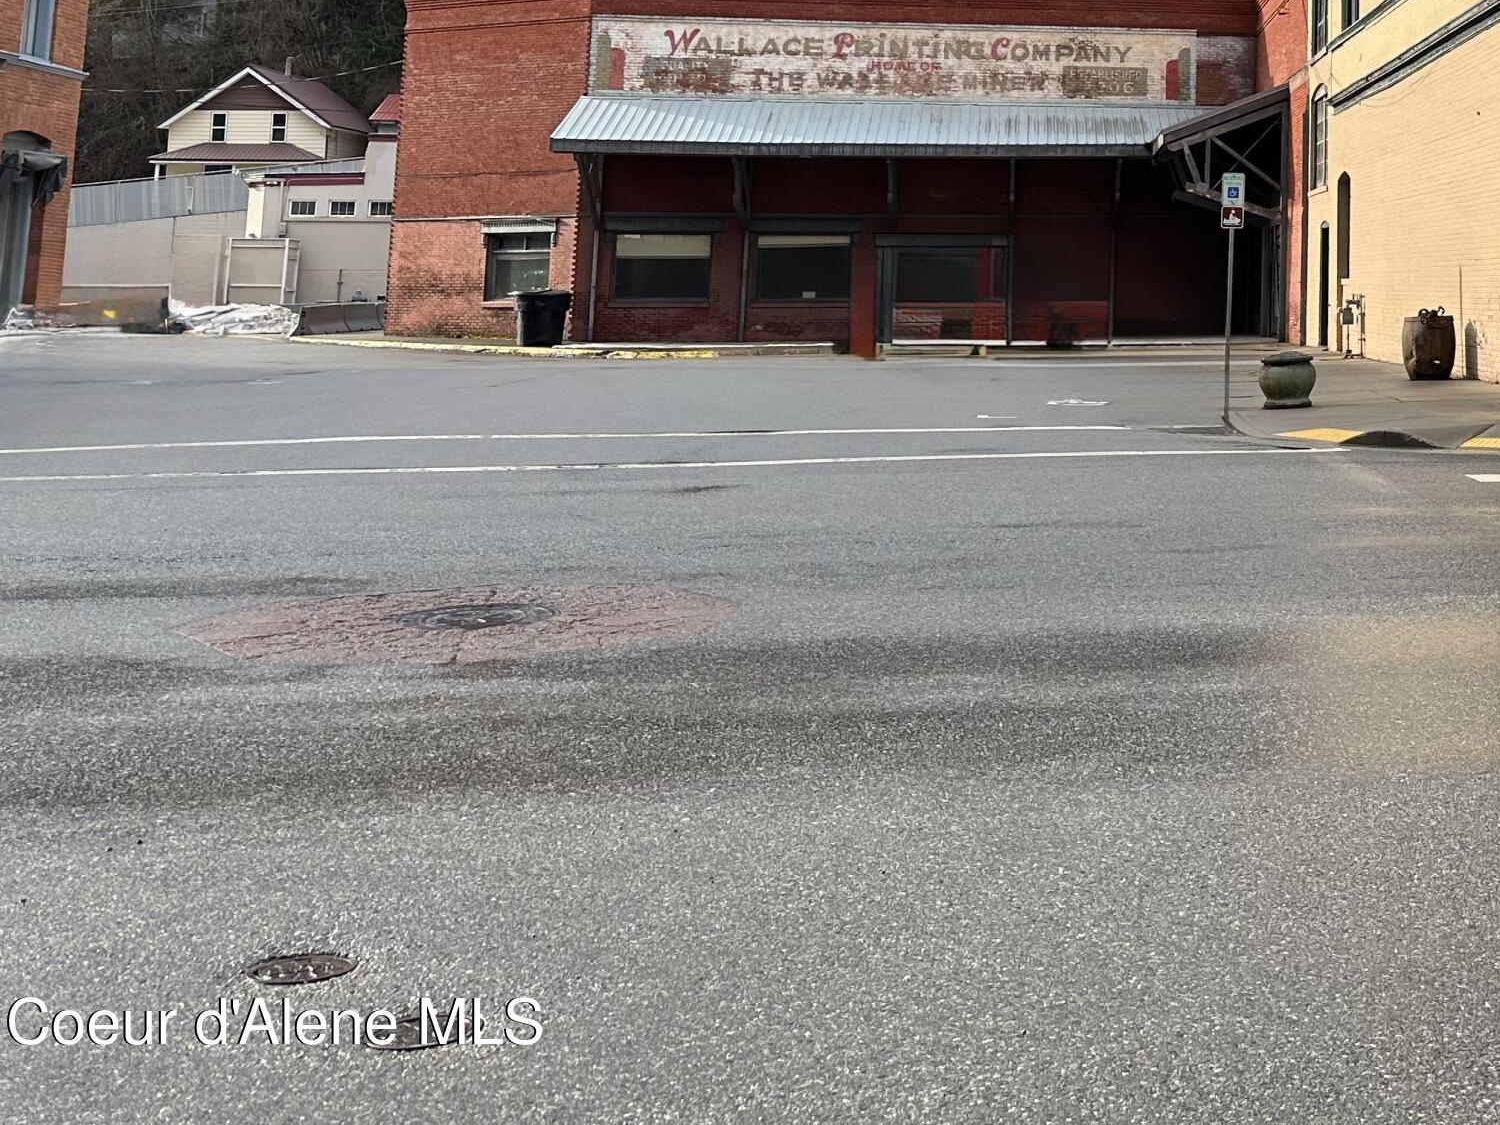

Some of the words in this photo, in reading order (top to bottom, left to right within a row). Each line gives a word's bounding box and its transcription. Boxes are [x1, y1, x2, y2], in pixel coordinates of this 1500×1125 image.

[663, 28, 825, 57] WALLACE
[831, 31, 987, 60] PRINTING
[990, 36, 1133, 64] COMPANY
